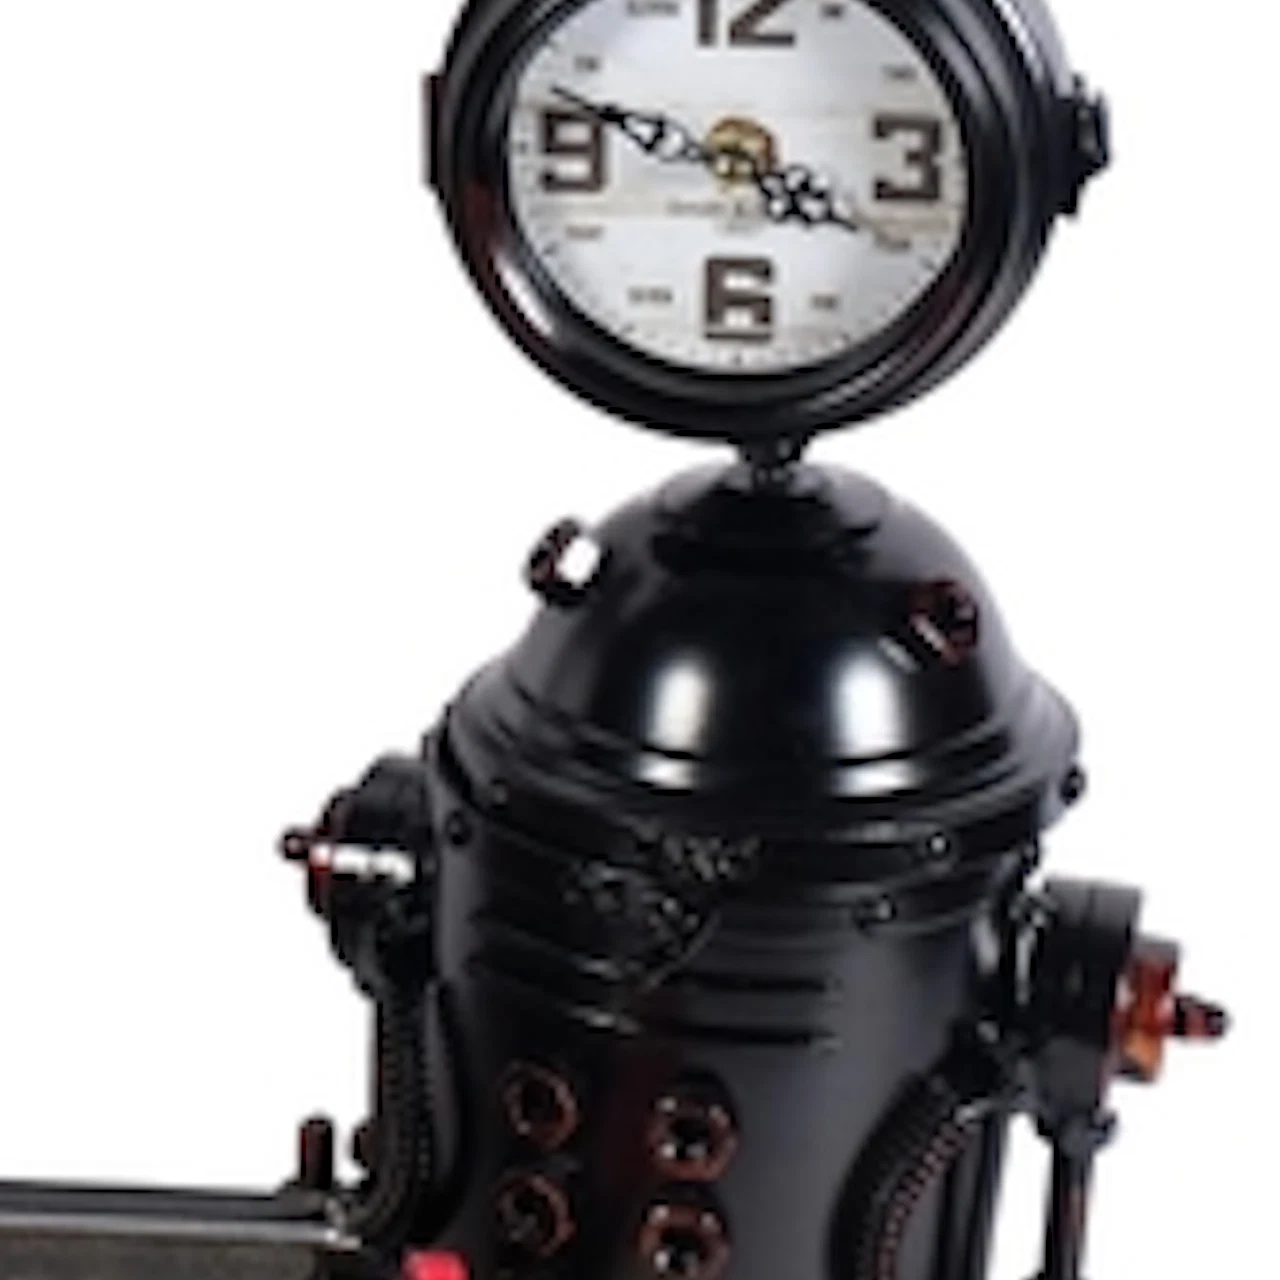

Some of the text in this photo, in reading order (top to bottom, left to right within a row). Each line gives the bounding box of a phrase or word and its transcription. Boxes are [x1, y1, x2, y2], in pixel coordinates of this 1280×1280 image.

[543, 112, 605, 193] 9
[874, 113, 940, 202] 3
[703, 257, 773, 342] 6
